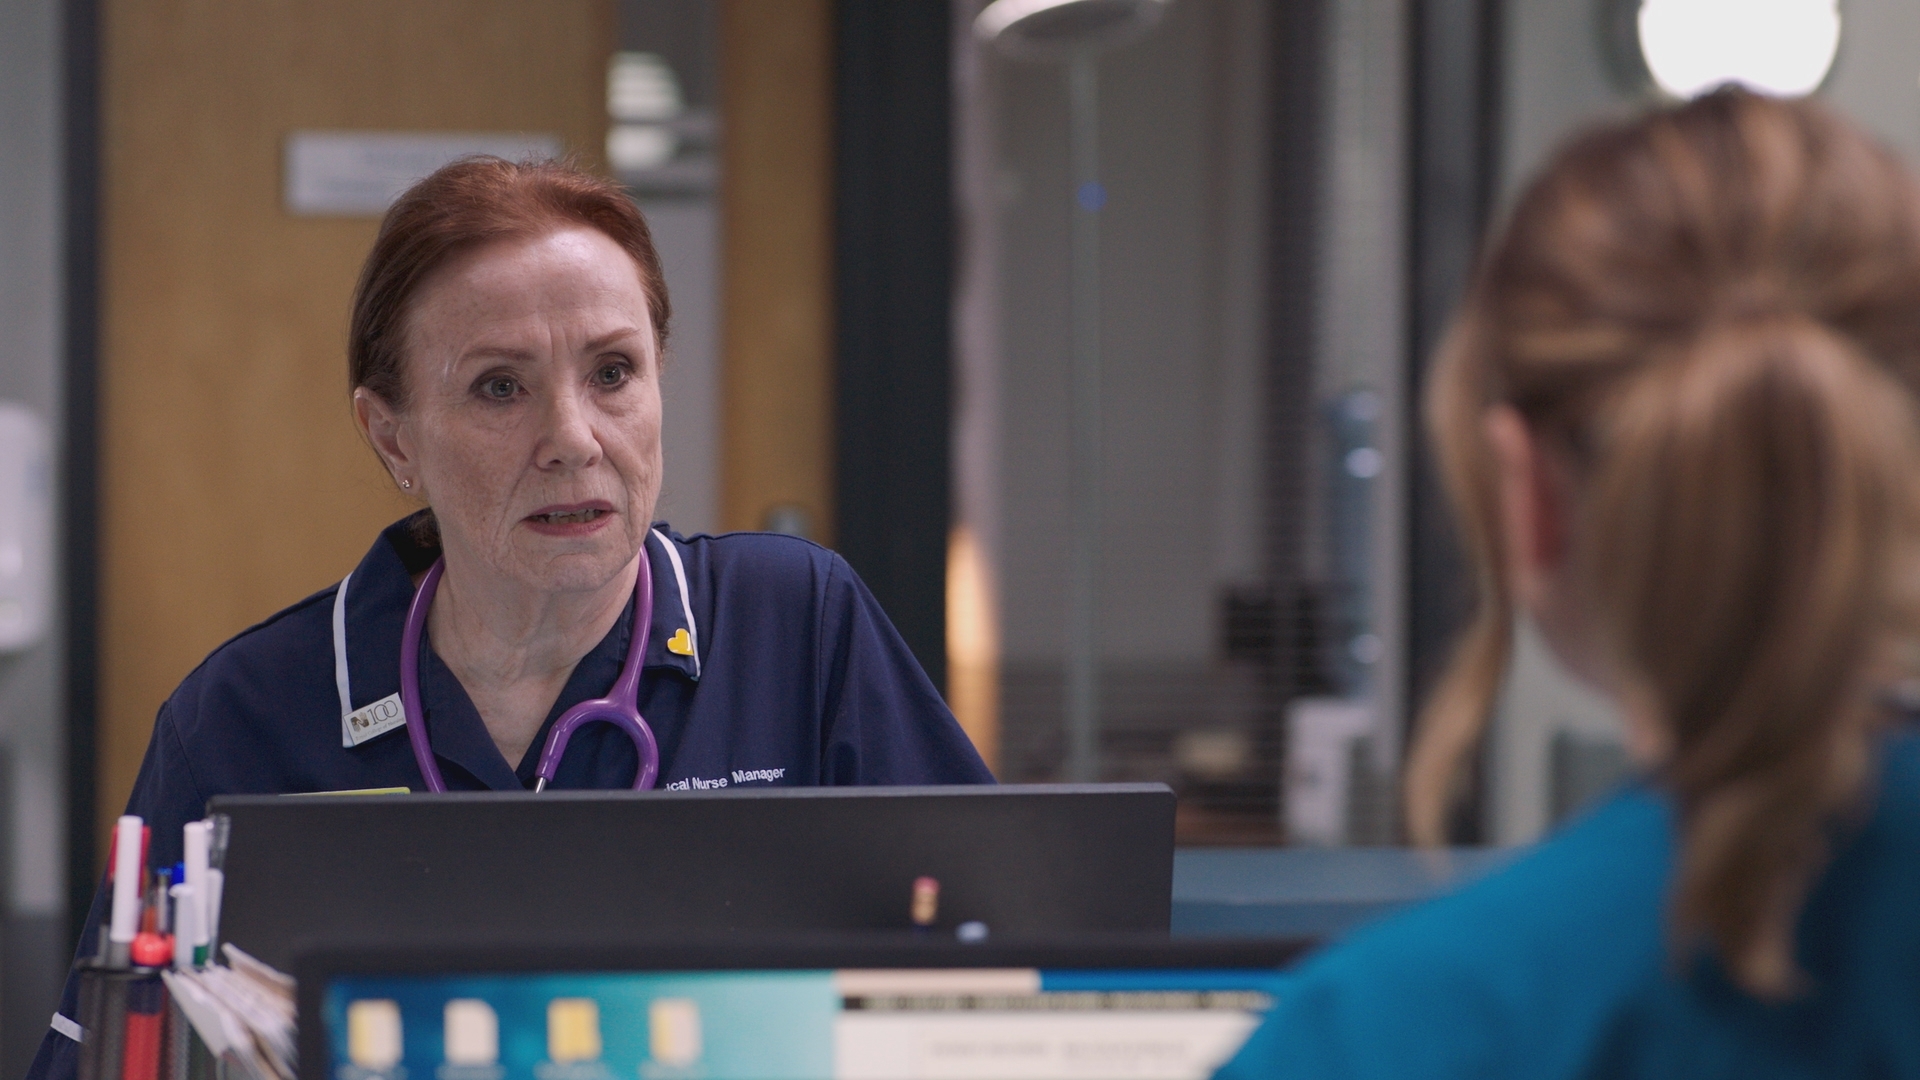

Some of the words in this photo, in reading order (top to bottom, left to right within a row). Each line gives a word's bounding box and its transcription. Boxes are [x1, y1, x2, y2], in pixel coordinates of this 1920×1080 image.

[664, 777, 690, 791] ical
[692, 776, 728, 790] Nurse
[731, 767, 786, 784] Manager
